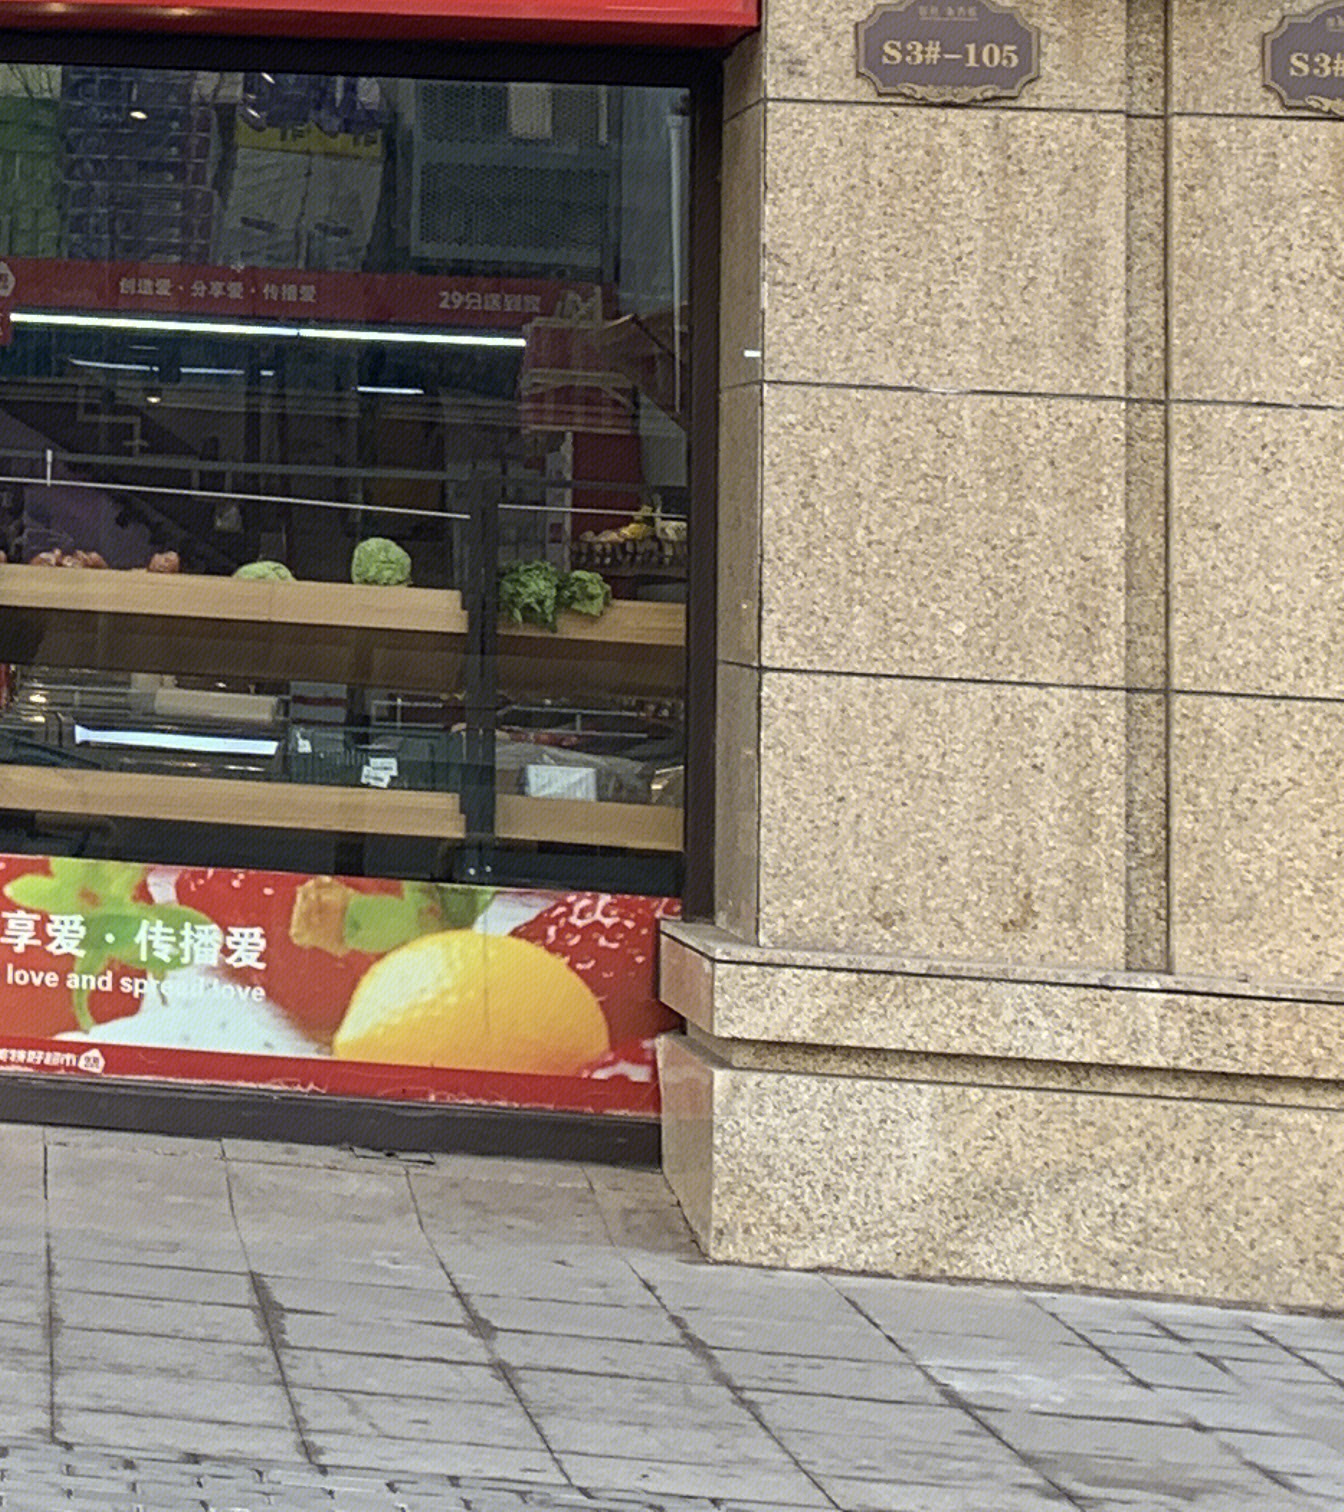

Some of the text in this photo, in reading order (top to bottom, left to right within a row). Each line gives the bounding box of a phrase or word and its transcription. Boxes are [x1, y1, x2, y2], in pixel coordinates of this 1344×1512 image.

[880, 39, 1020, 69] S3#-105
[133, 918, 268, 971] 传播爱
[5, 967, 59, 989] love
[66, 969, 113, 993] and
[119, 975, 206, 999] spred
